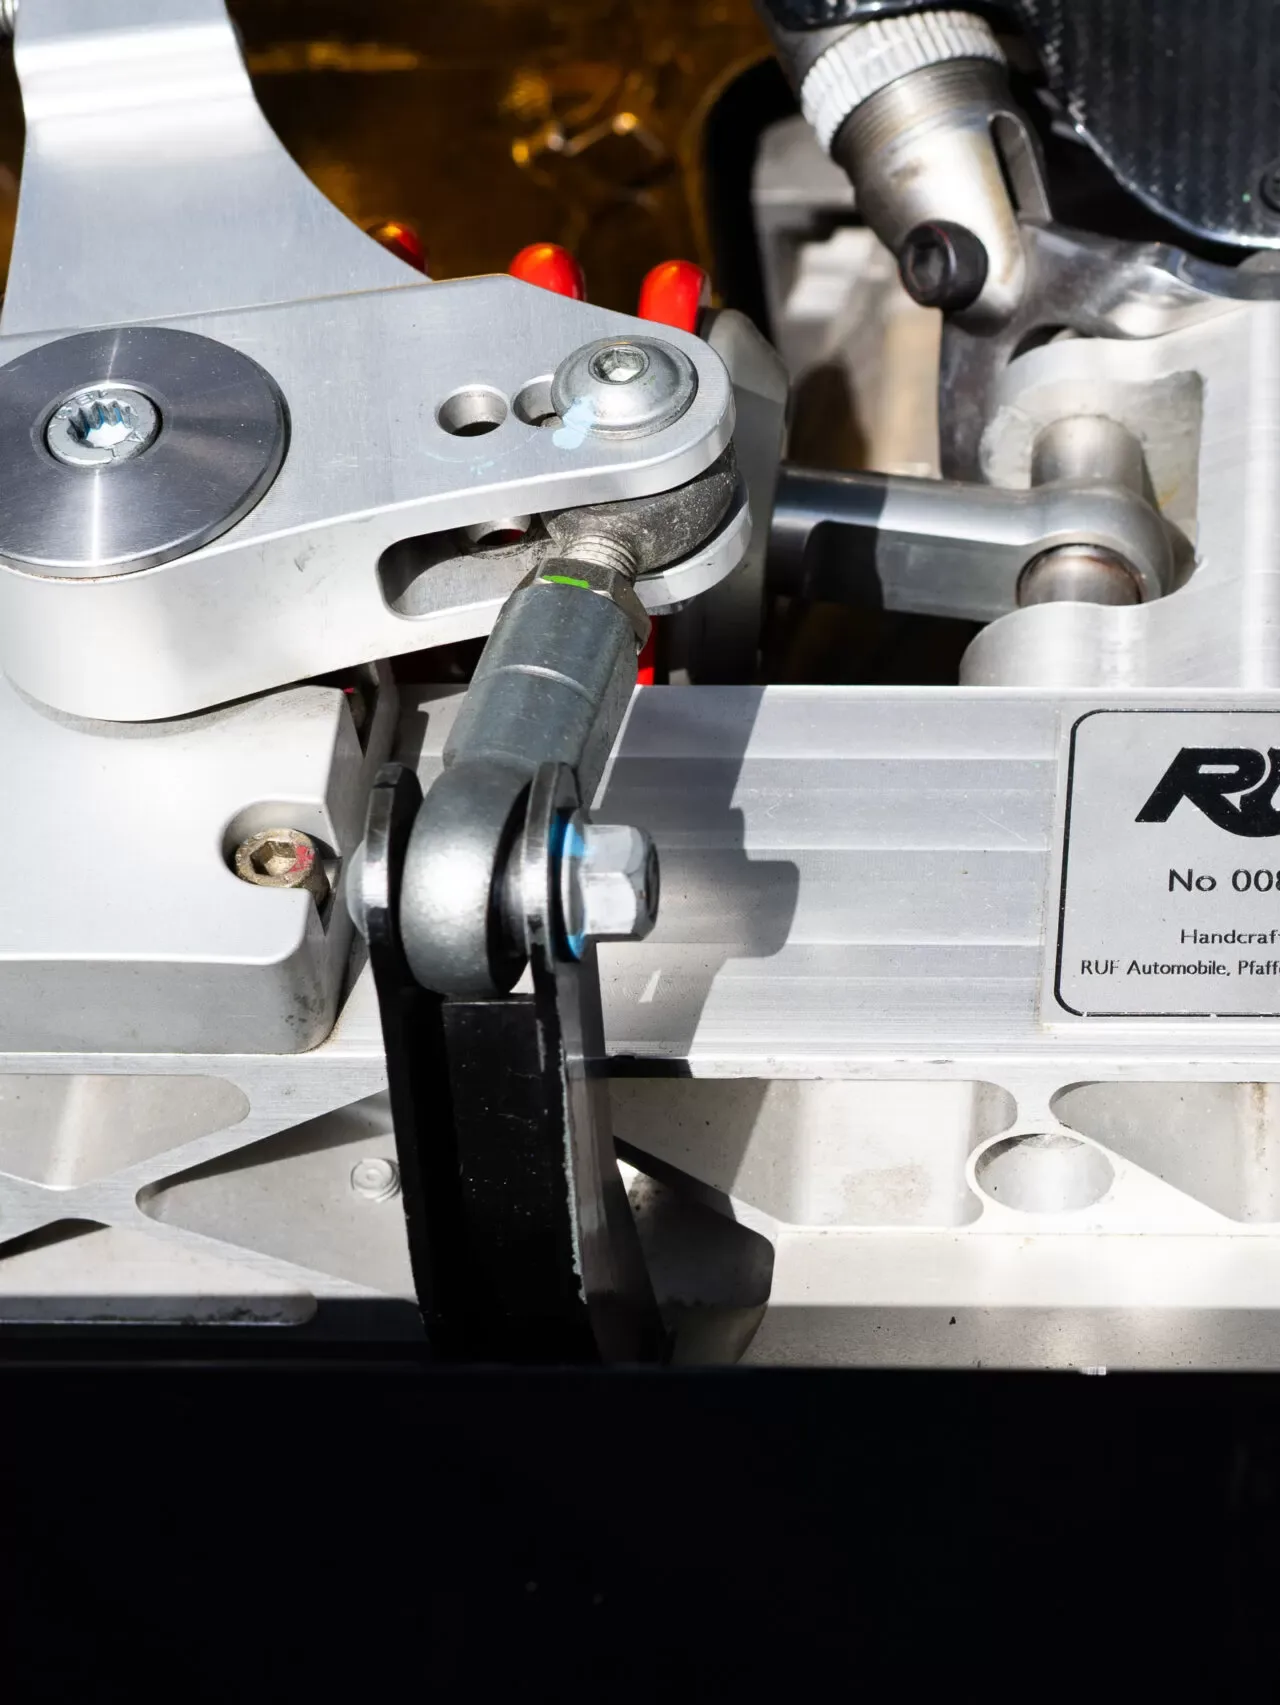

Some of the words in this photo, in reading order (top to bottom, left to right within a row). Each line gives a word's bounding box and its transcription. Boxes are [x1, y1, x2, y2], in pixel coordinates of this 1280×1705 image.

[1168, 868, 1217, 893] No
[1080, 959, 1120, 975] RUF
[1126, 959, 1231, 978] Automobile,
